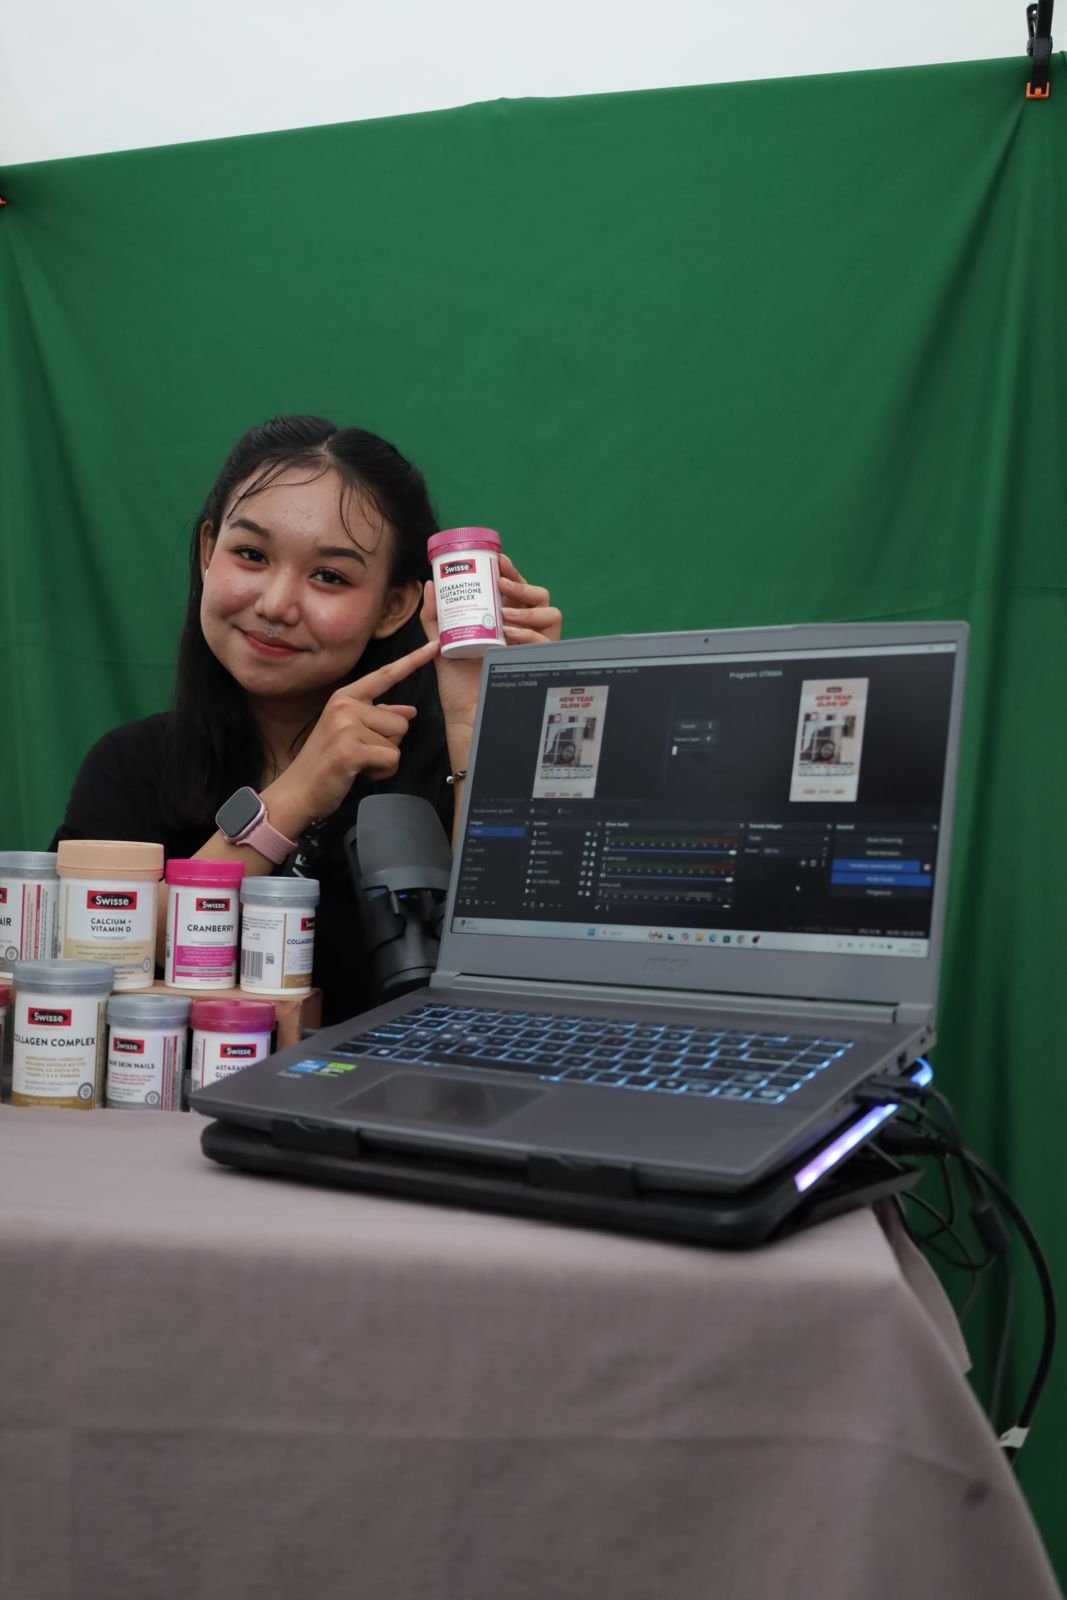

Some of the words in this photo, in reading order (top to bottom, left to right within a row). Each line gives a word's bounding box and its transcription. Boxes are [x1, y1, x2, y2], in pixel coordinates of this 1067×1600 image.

[444, 563, 469, 574] Swisse
[440, 582, 481, 594] ASTAXANTHIN
[440, 587, 482, 600] GLUTATHIONE
[445, 595, 475, 605] COMPLEX
[95, 895, 131, 906] Swisse
[201, 901, 226, 909] Swisse
[90, 925, 124, 933] VITAMIN
[187, 924, 234, 932] CRANBERRY
[33, 1012, 64, 1023] Swisse
[51, 1037, 95, 1047] COMPLEX
[116, 1041, 139, 1051] Swisse
[226, 1046, 252, 1056] Swisse
